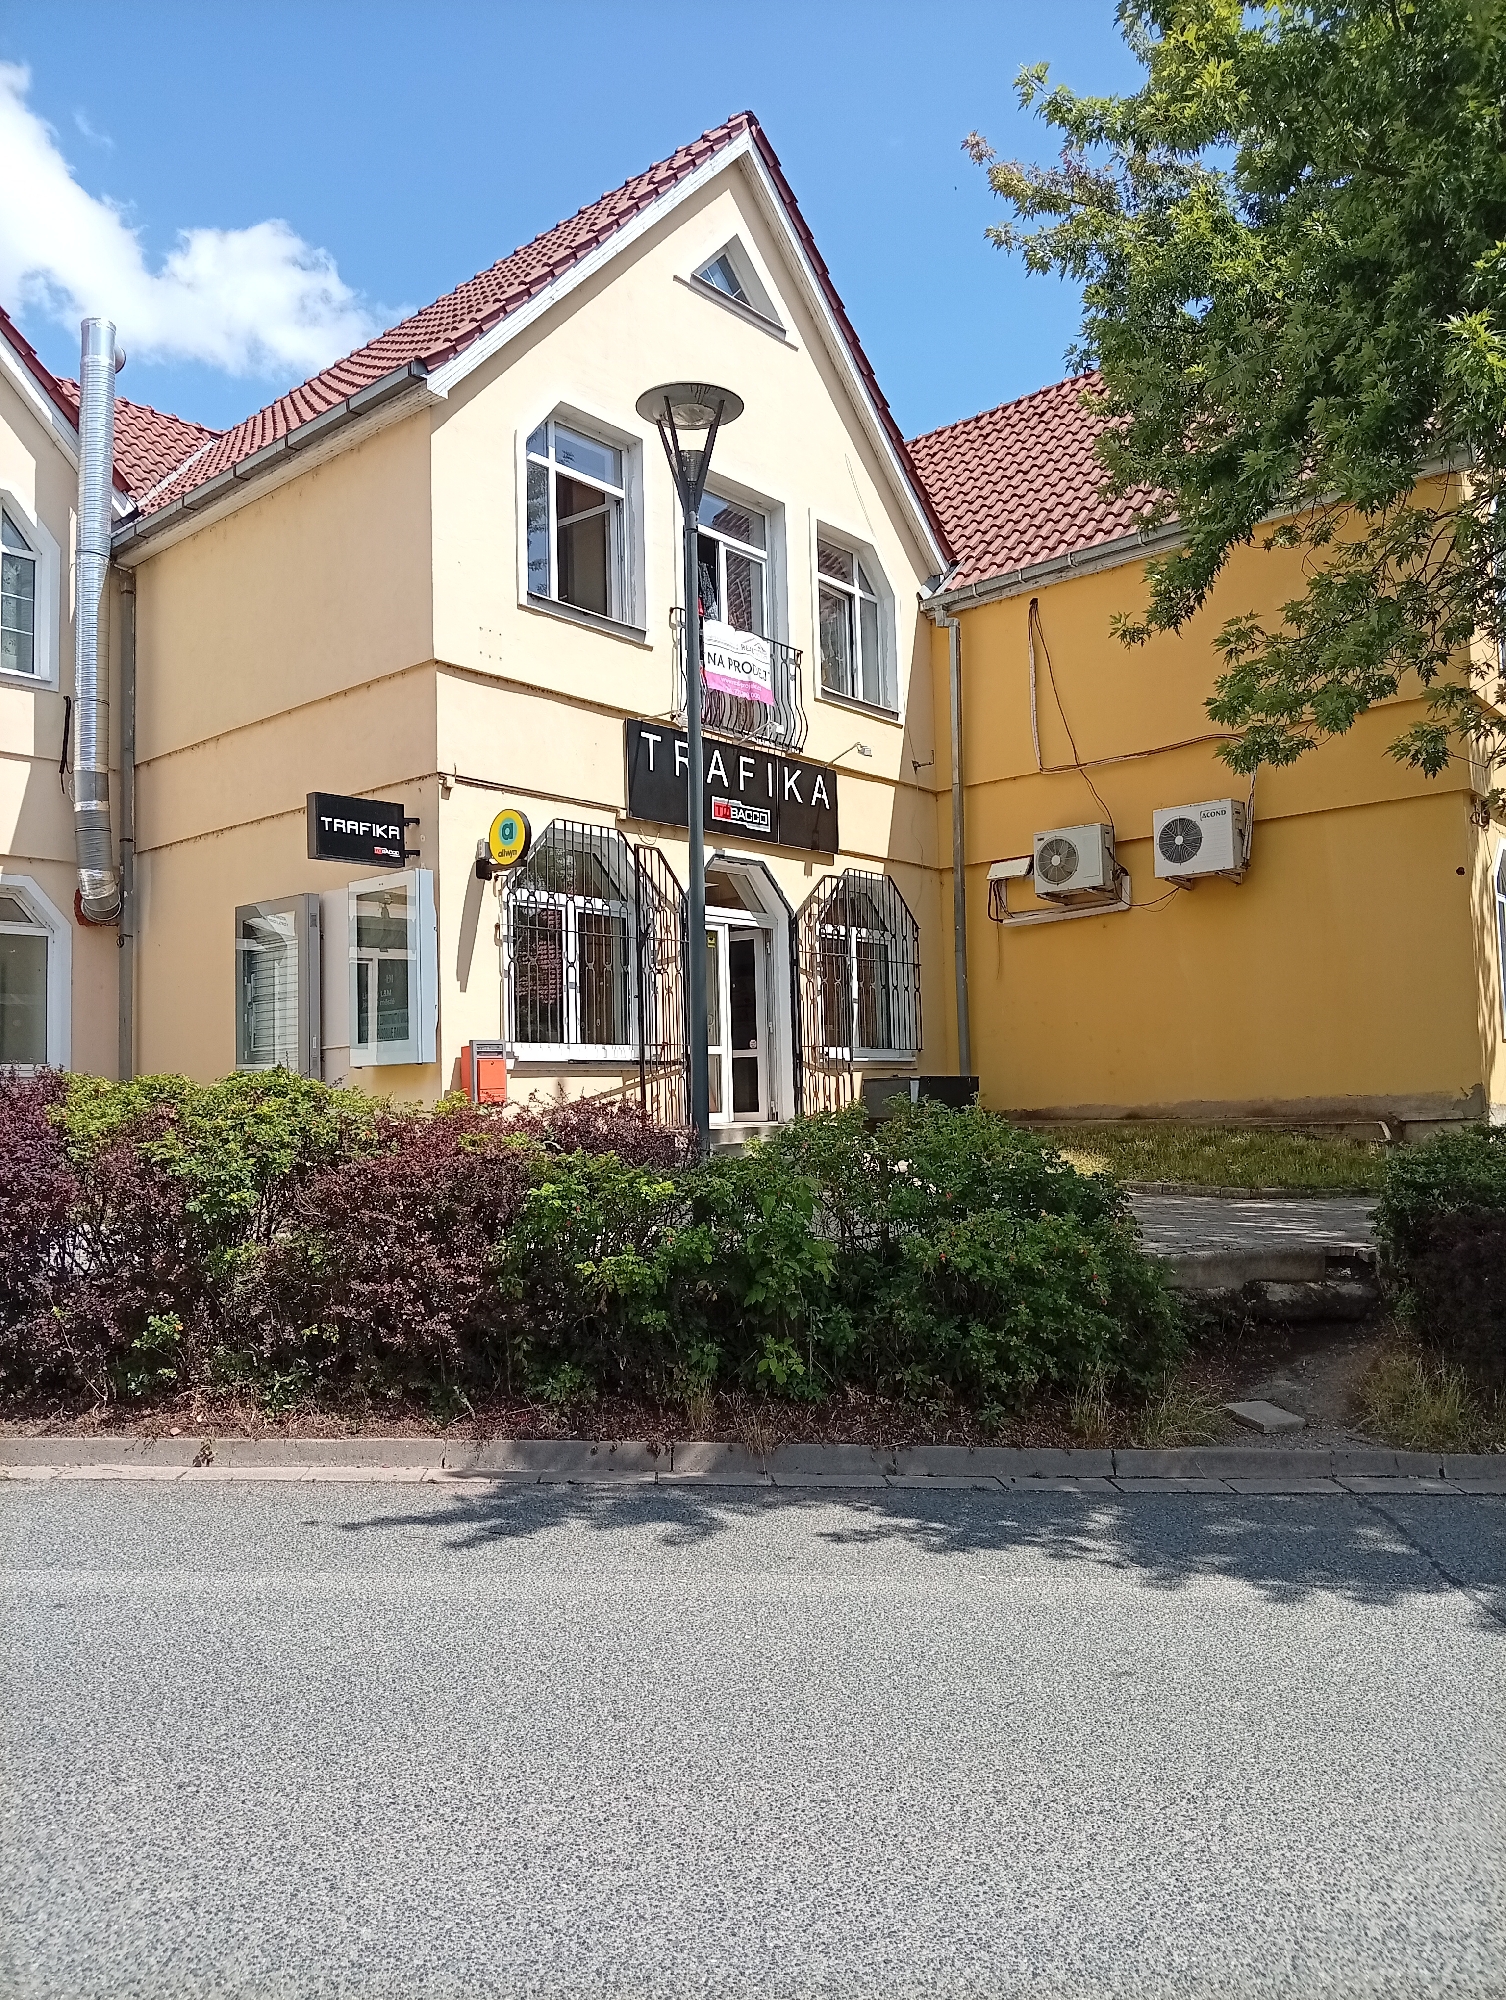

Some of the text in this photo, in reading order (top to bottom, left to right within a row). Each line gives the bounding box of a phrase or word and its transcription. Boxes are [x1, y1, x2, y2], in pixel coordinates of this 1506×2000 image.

[707, 652, 767, 682] NA PRODEJ
[640, 731, 830, 810] TRAFIKA
[715, 804, 768, 825] TOBACCO
[1201, 809, 1227, 819] ACOND
[320, 816, 401, 840] TRAFIKA
